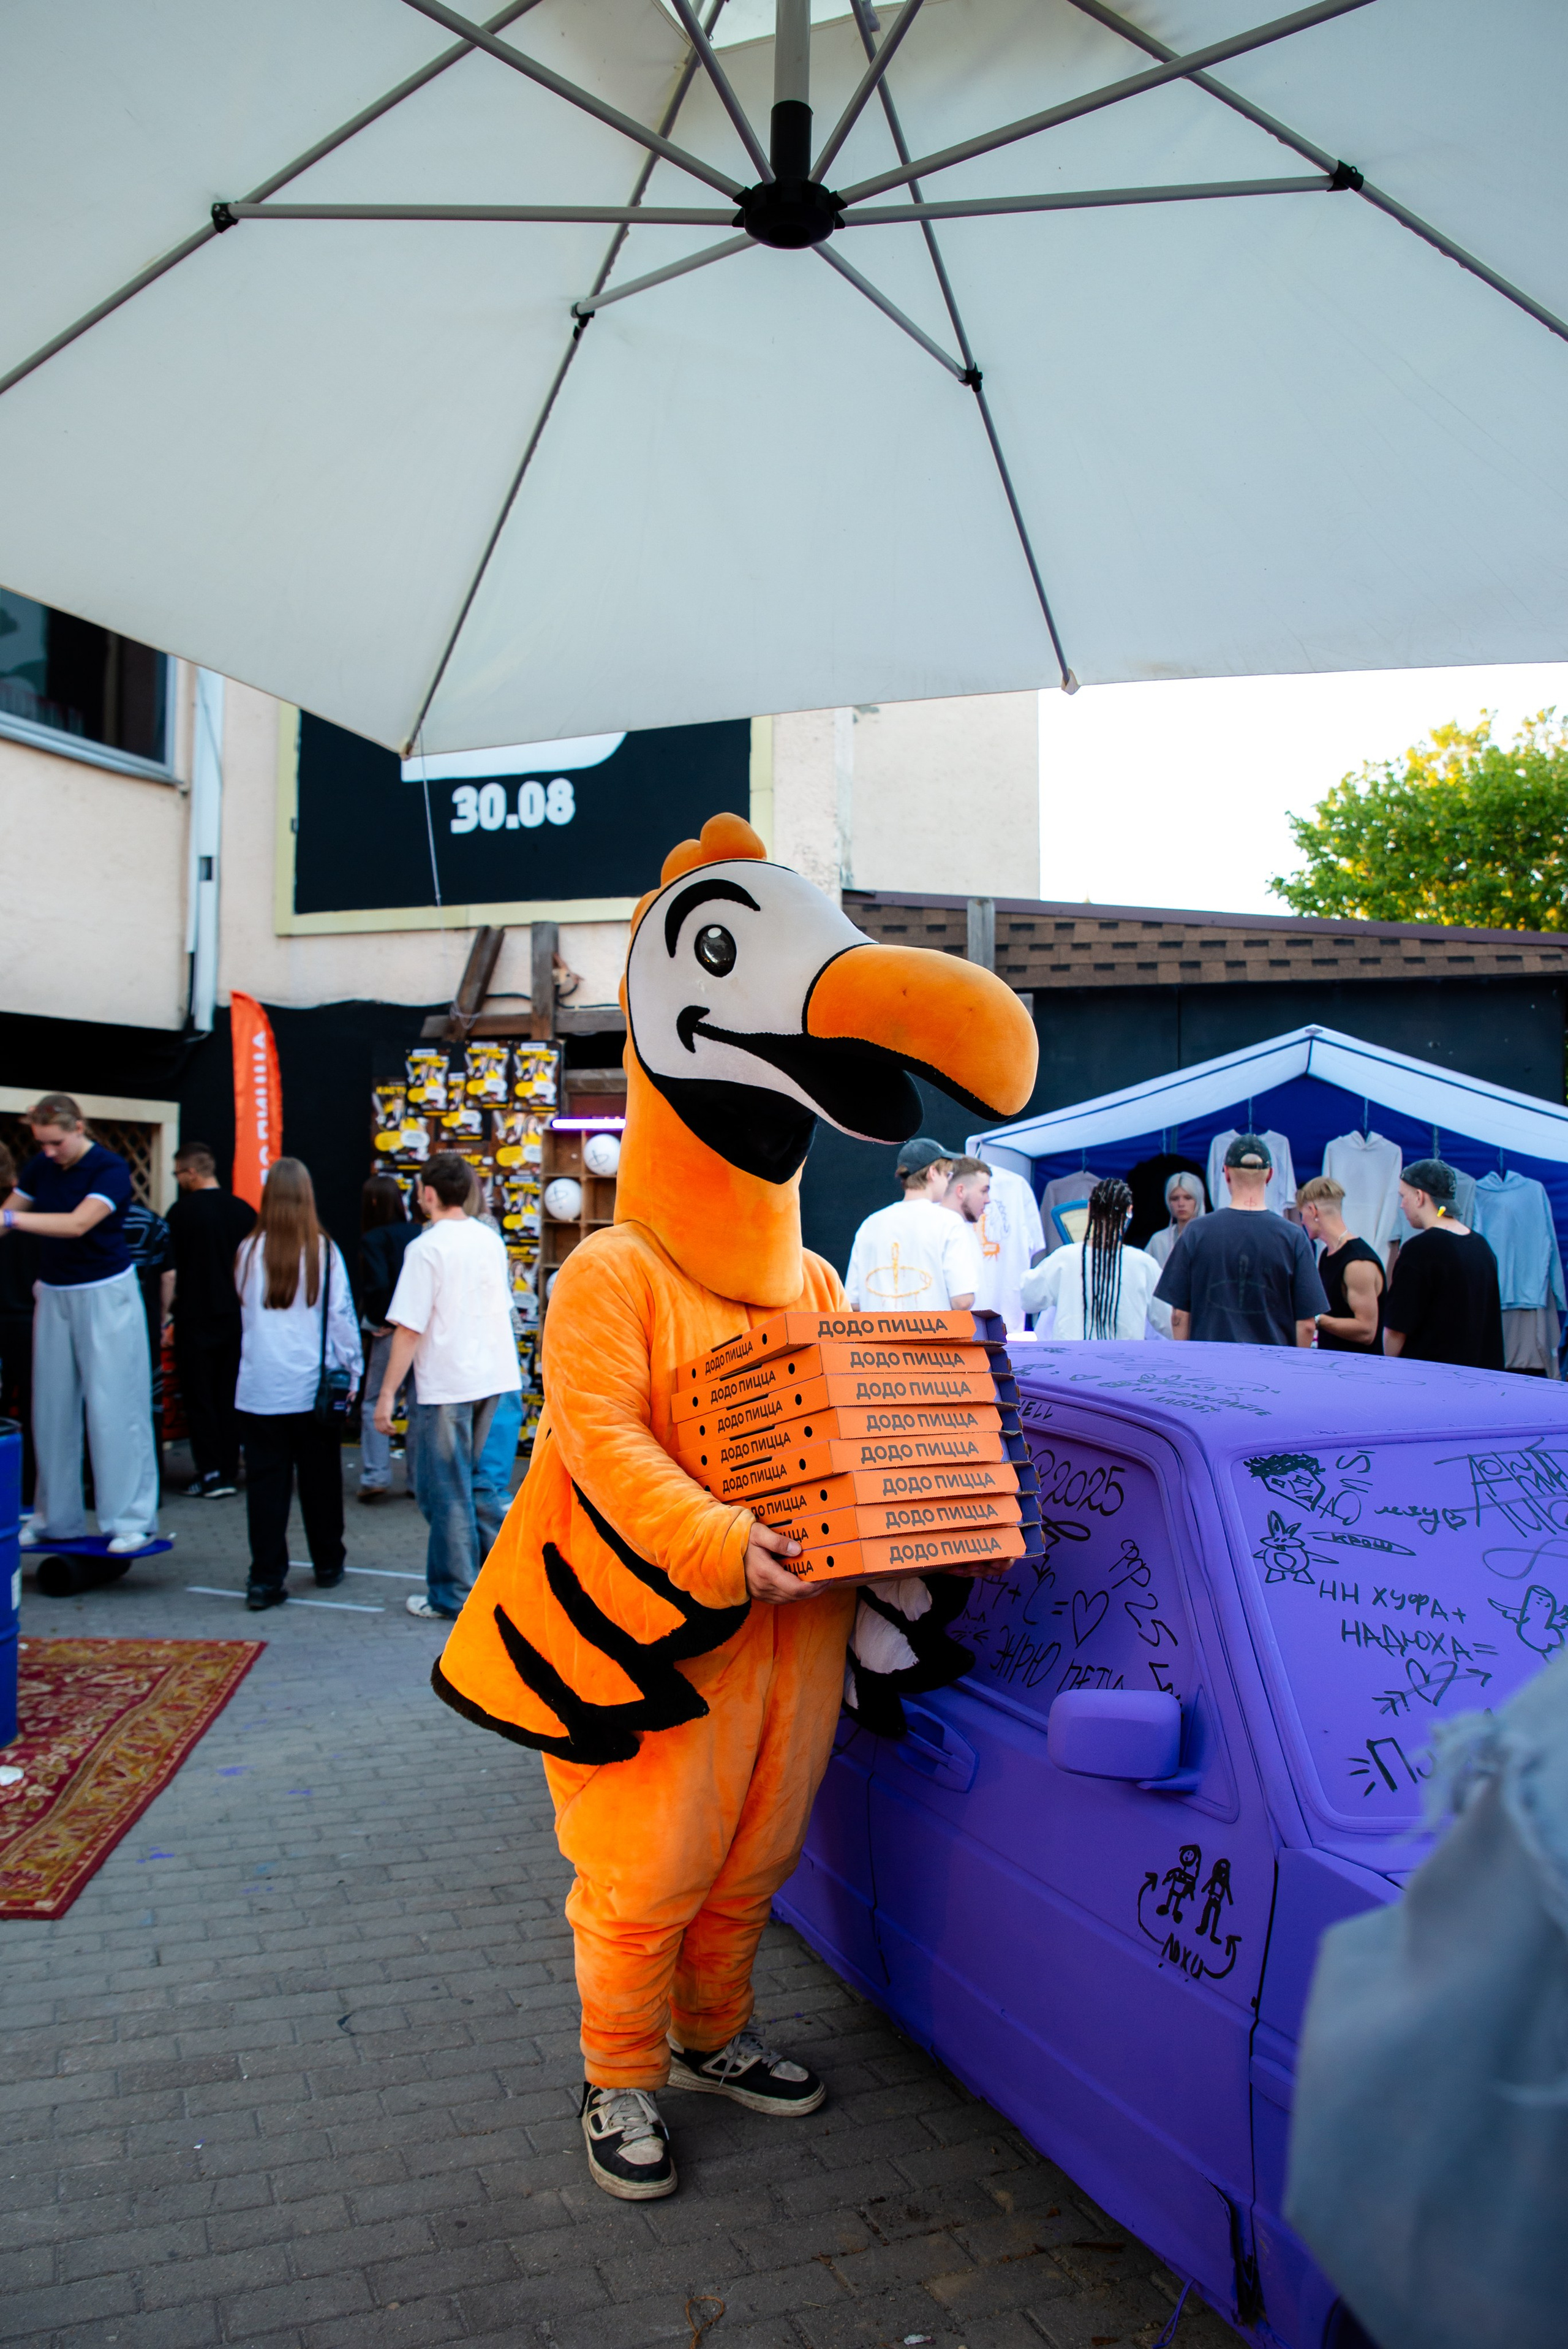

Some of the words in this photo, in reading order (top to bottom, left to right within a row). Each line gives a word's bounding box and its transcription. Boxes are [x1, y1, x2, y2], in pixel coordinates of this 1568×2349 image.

[451, 777, 576, 834] 30.08
[818, 1319, 874, 1337] ДОДО
[878, 1318, 948, 1335] ПИЦЦА
[705, 1354, 725, 1375] ДОДО
[725, 1341, 753, 1363] ПИЦЦА
[850, 1351, 900, 1368] ДОДО
[903, 1352, 965, 1367] ПИЦЦА
[710, 1383, 737, 1404] ДОДО
[739, 1370, 776, 1393] ПИЦЦА
[856, 1382, 906, 1399] ДОДО
[910, 1380, 971, 1398] ПИЦЦА
[717, 1412, 744, 1434] ДОДО
[745, 1400, 783, 1422] ПИЦЦА
[866, 1413, 916, 1432] ДОДО
[919, 1412, 978, 1429] ПИЦЦА
[720, 1443, 750, 1464] ДОДО
[750, 1432, 791, 1453] ПИЦЦА
[861, 1445, 912, 1464] ДОДО
[916, 1441, 979, 1459] ПИЦЦА
[722, 1474, 749, 1494] ДОДО
[750, 1464, 788, 1485] ПИЦЦА
[883, 1477, 931, 1495] ДОДО
[935, 1472, 995, 1490] ПИЦЦА
[766, 1495, 807, 1515] ПИЦЦА
[886, 1509, 934, 1528] ДОДО
[938, 1504, 998, 1522] ПИЦЦА
[889, 1545, 938, 1564] ДОДО
[941, 1538, 1001, 1556] ПИЦЦА
